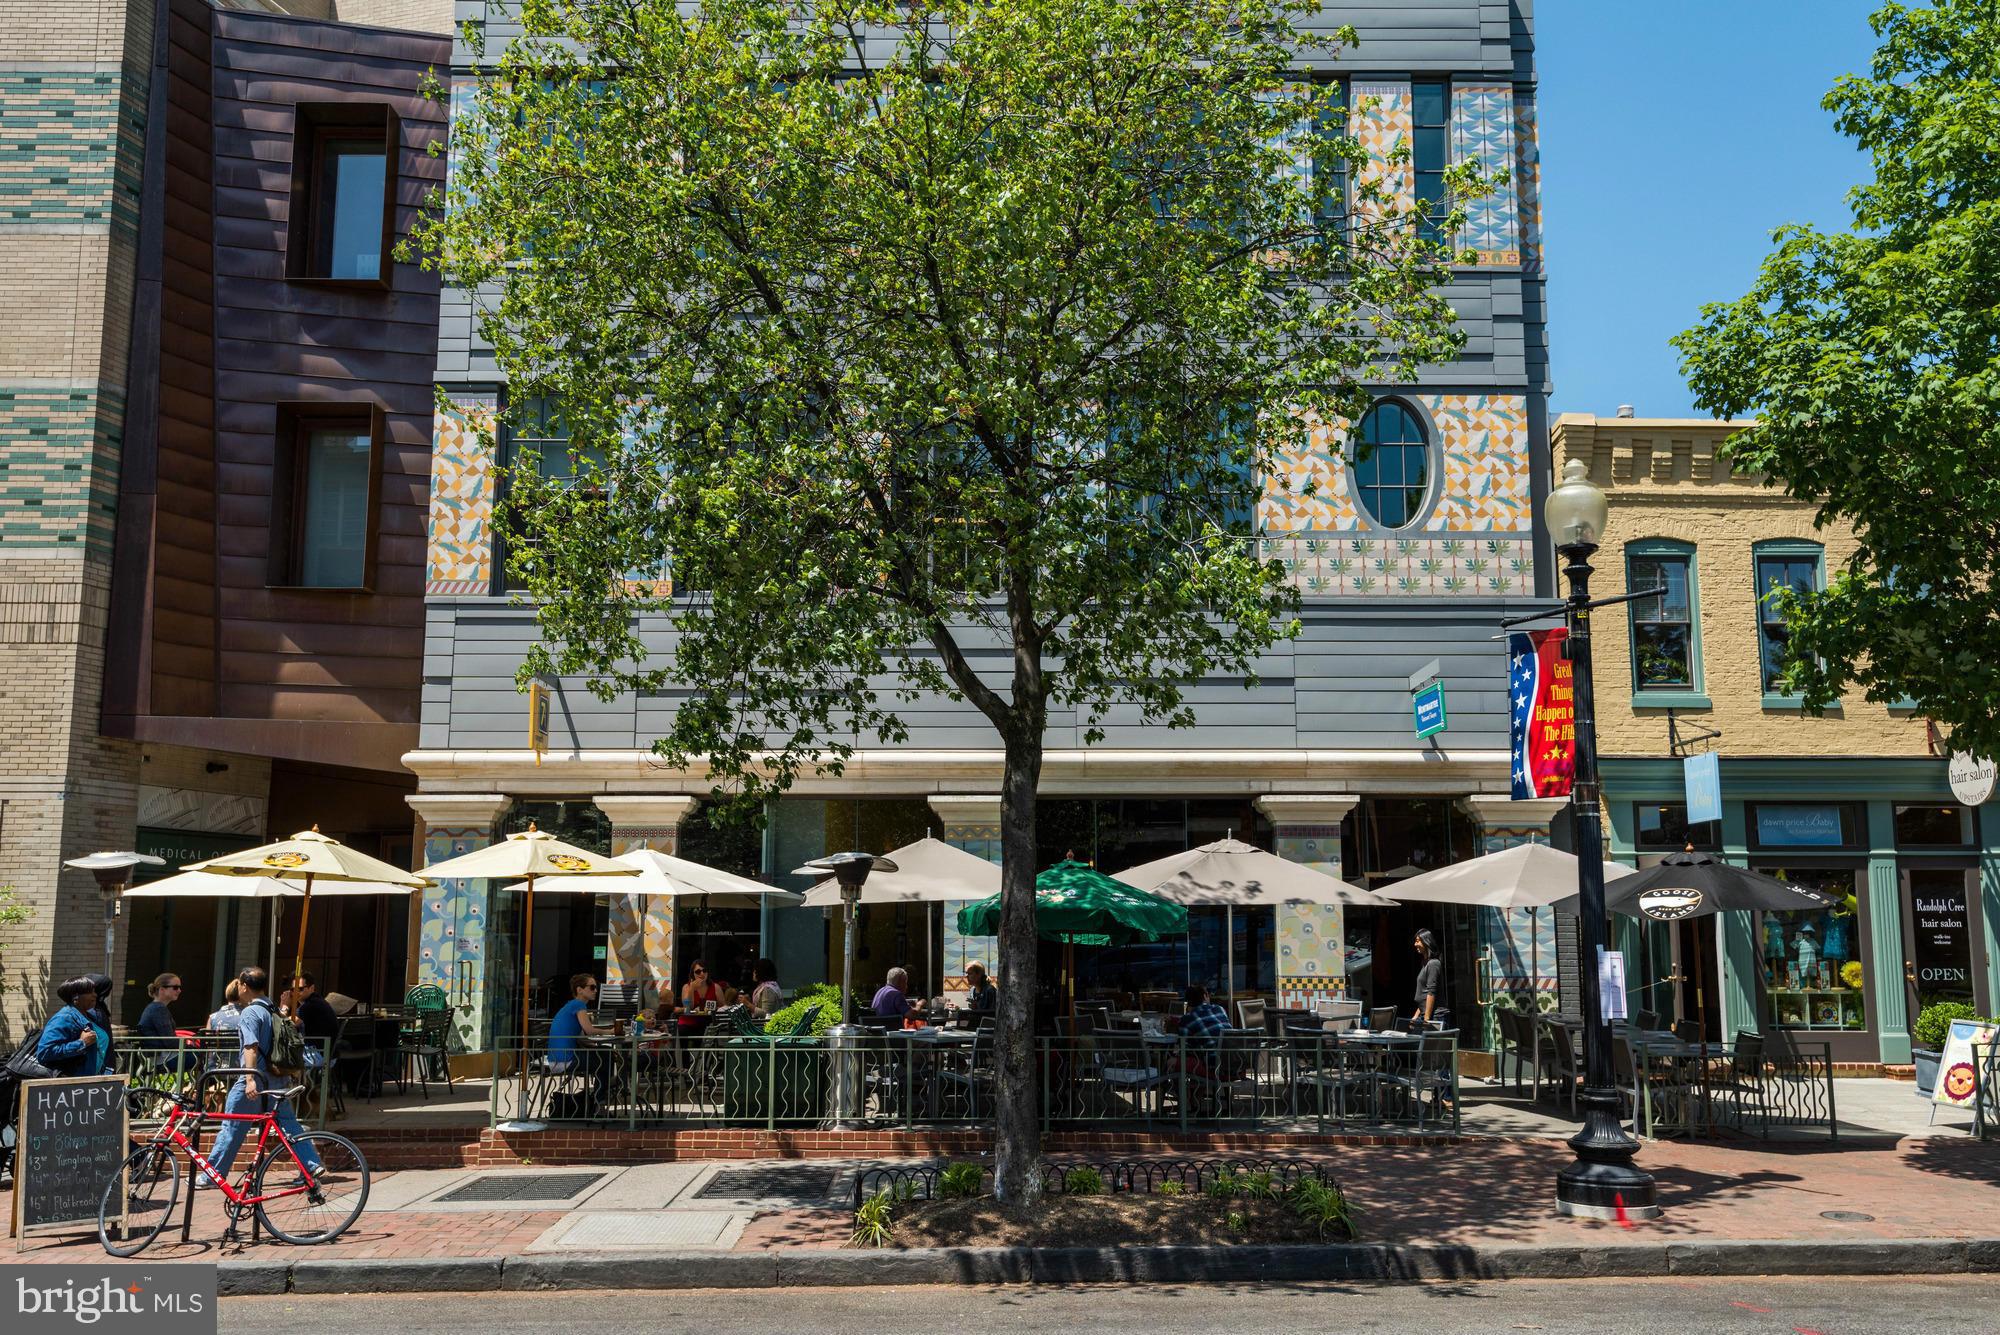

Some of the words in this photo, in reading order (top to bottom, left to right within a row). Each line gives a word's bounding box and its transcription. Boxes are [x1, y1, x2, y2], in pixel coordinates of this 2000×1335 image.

[1553, 663, 1573, 679] Great
[1550, 684, 1574, 702] Thing
[1535, 705, 1567, 723] Happen
[1568, 706, 1575, 719] o
[1544, 725, 1560, 742] The
[1950, 769, 1968, 785] hair
[1969, 768, 1993, 782] salon
[1959, 790, 1987, 804] UPSTAIRS
[1785, 817, 1804, 829] price
[149, 847, 202, 861] MEDICAL
[1649, 905, 1694, 918] ISLAND
[1916, 898, 1947, 914] Randolph
[1948, 898, 1965, 912] Cree
[1921, 918, 1939, 928] hair
[1940, 918, 1962, 928] salon
[1921, 967, 1965, 981] OPEN
[38, 1086, 114, 1110] HAPPY
[44, 1108, 106, 1130] HOUR
[185, 1145, 223, 1183] MASI
[54, 1192, 100, 1210] Flatbreads
